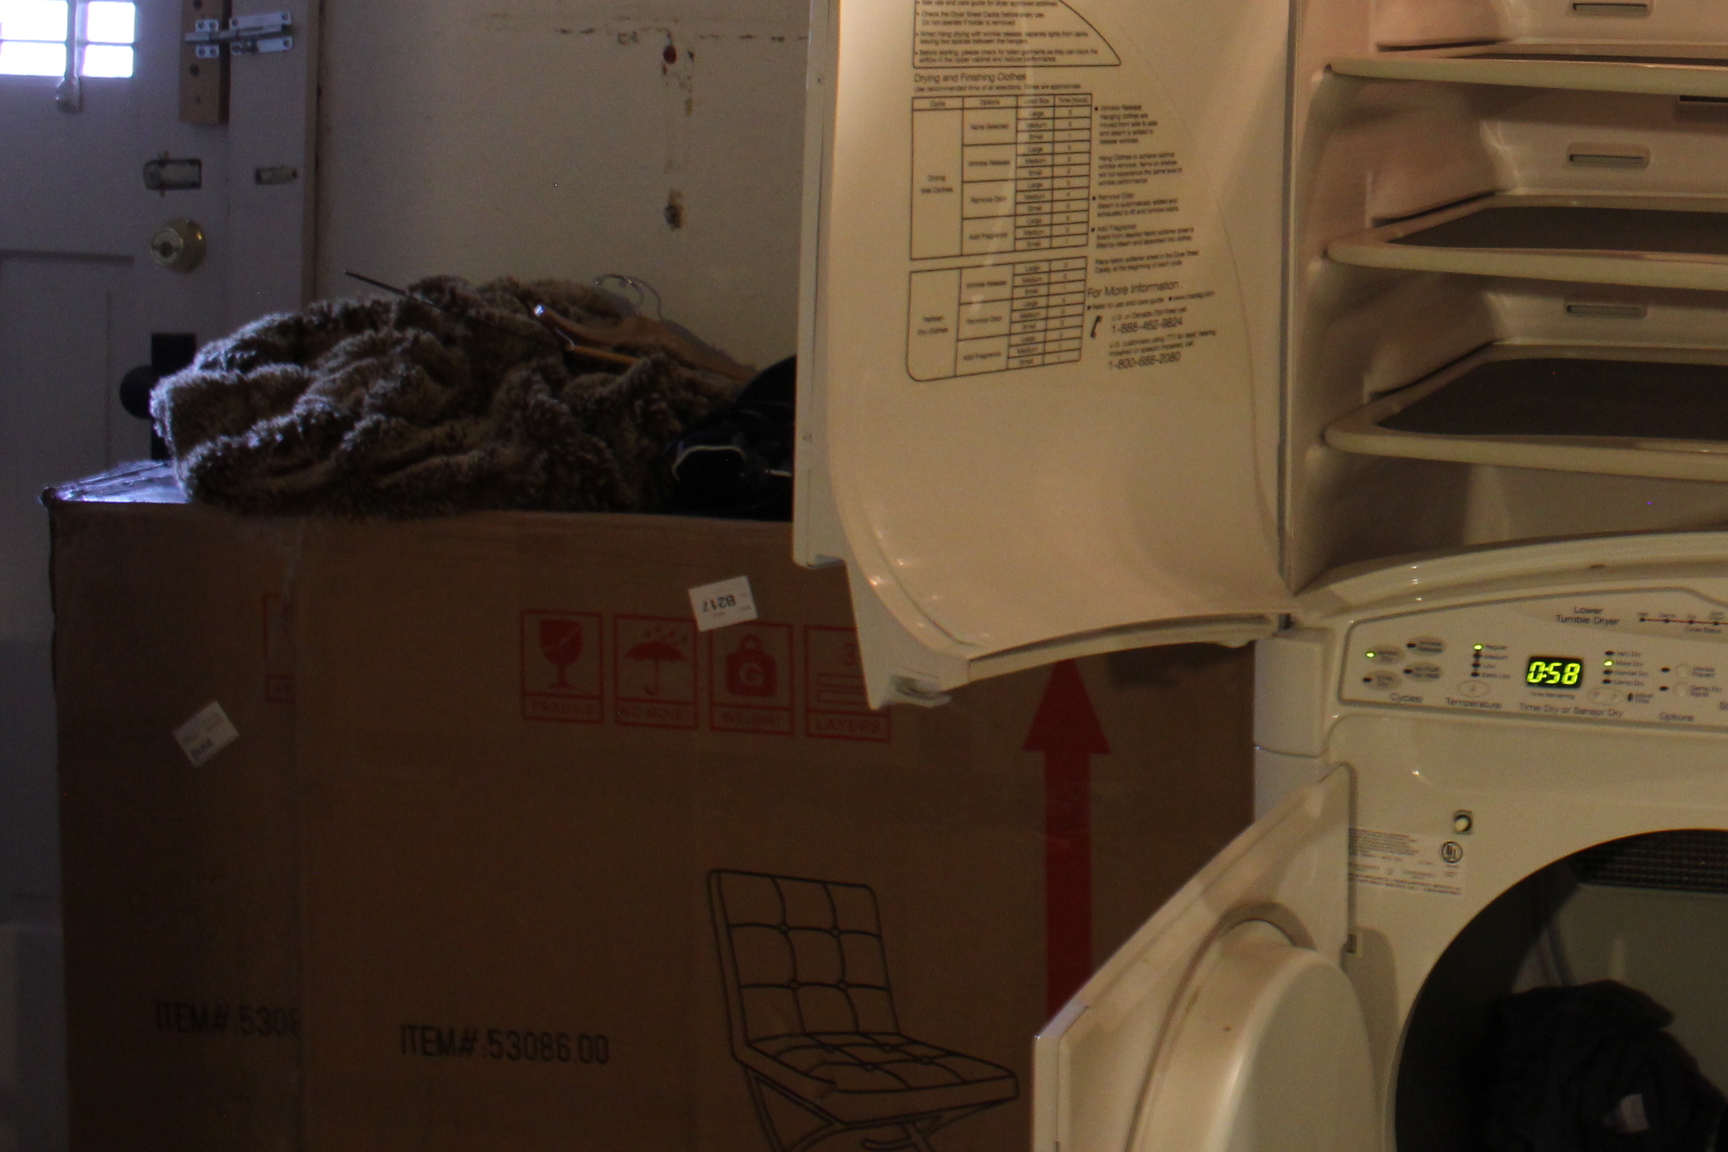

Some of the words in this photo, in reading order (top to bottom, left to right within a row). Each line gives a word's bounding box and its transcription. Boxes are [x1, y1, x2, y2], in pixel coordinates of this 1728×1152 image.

[914, 73, 940, 83] Drying
[942, 73, 958, 82] and
[960, 73, 995, 83] Finishing
[997, 72, 1026, 81] Clothes
[1087, 287, 1102, 298] For
[1105, 286, 1128, 296] More
[1131, 281, 1179, 294] Information
[1574, 606, 1603, 614] Lower
[1555, 614, 1591, 624] Tumble
[1594, 616, 1620, 626] Dryer
[1526, 661, 1581, 685] 0:58
[1390, 692, 1423, 703] Cycles
[1445, 697, 1502, 709] Temperature
[1520, 703, 1542, 711] Time
[1544, 704, 1561, 714] Dry
[1574, 706, 1605, 716] Sensor
[1608, 708, 1625, 718] Dry
[1659, 712, 1694, 722] Options
[815, 718, 884, 735] LAYERS
